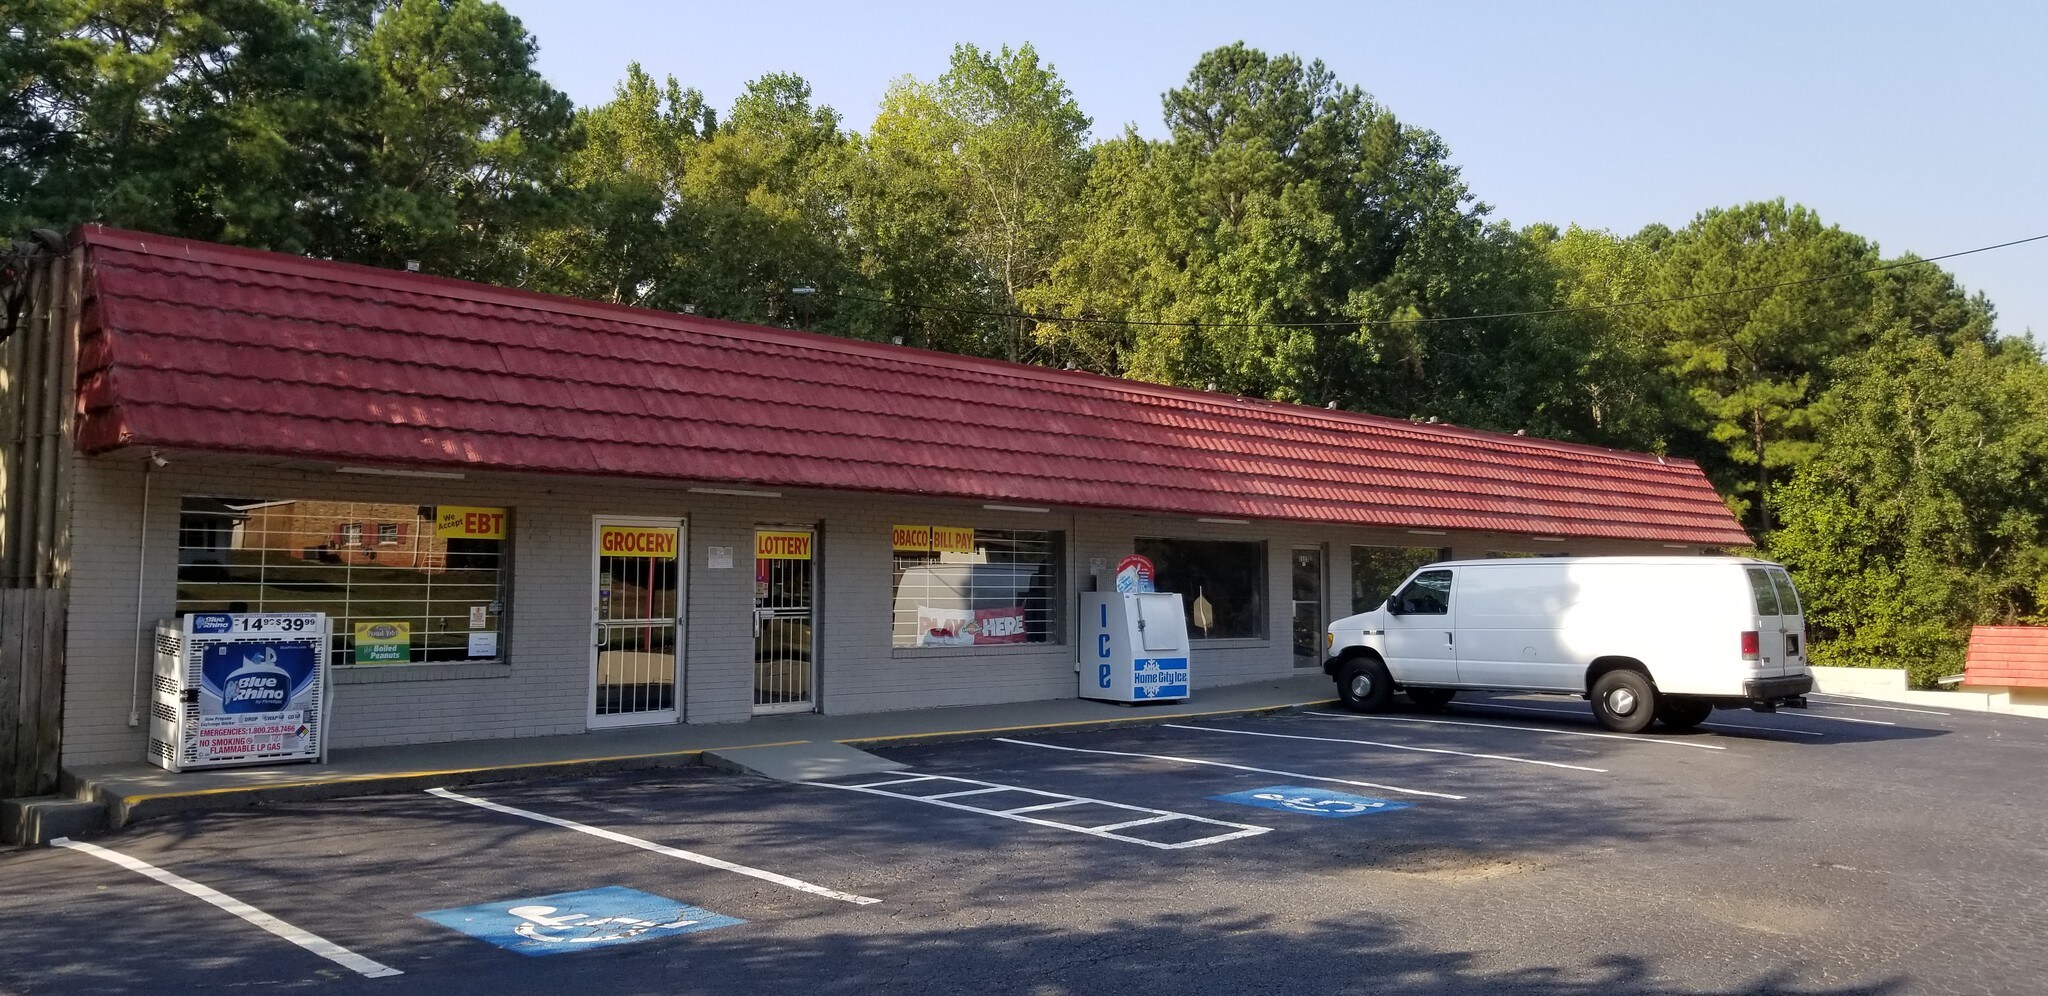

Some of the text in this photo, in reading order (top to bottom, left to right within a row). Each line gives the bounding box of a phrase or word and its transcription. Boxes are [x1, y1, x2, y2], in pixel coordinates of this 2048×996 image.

[438, 519, 464, 530] Accept
[465, 513, 504, 534] EBT
[602, 532, 674, 552] GROCERY
[893, 529, 928, 547] OBACCO
[934, 532, 972, 549] BILL PAY
[758, 536, 809, 555] LOTTERY
[920, 616, 966, 638] PLAY
[982, 615, 1025, 637] HERE
[373, 644, 397, 652] Boiled
[239, 676, 277, 689] Blue
[1134, 671, 1187, 685] Home City Ice
[233, 687, 284, 701] Rhino
[200, 739, 210, 747] NO
[211, 737, 246, 746] SMOKING
[209, 744, 255, 755] FLAMMABLE
[267, 743, 281, 751] GAS
